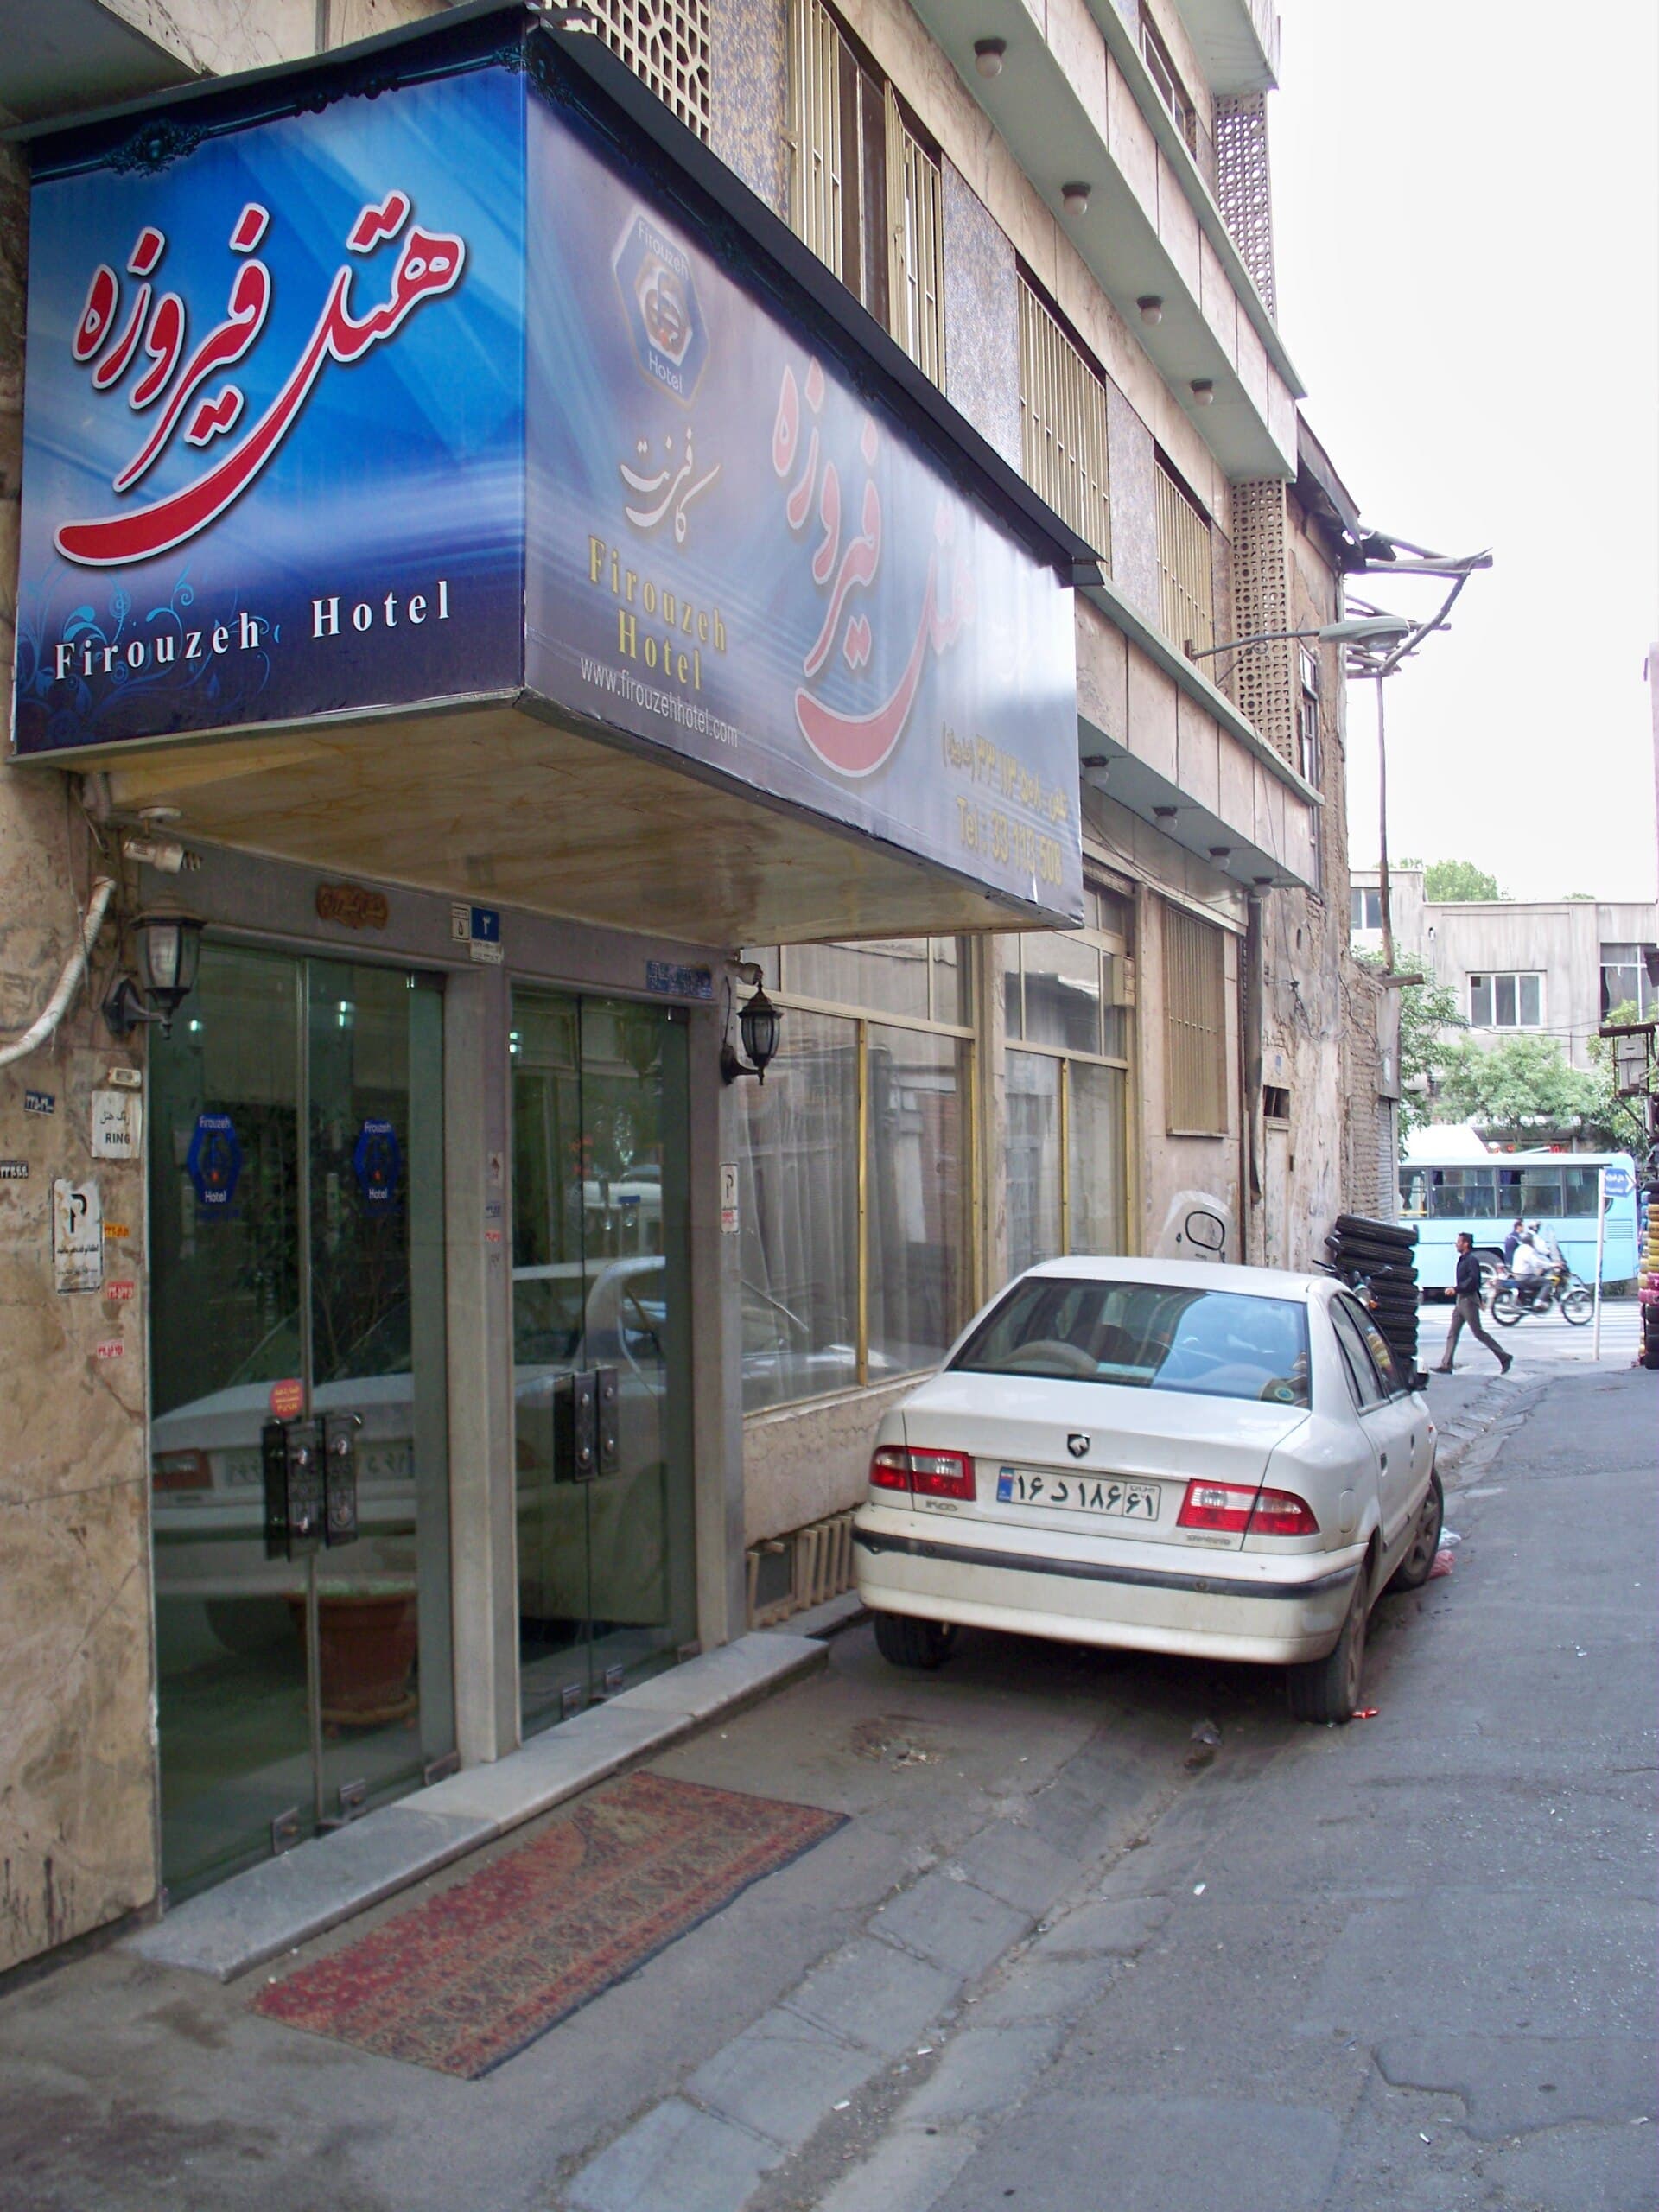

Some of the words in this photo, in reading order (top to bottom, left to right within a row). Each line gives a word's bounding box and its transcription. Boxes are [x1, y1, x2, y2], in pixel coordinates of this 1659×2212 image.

[638, 220, 690, 280] Firouzeh
[54, 189, 465, 565] هتل
[73, 203, 270, 493] فیروزه
[648, 350, 683, 394] Hotel
[772, 355, 881, 677] فیروزه
[55, 614, 261, 680] Firouzeh
[312, 582, 450, 640] Hotel
[588, 536, 726, 652] Firouzeh
[618, 609, 701, 690] Hotel
[581, 657, 738, 747] www.firouzehhotel.com
[105, 1133, 130, 1144] RING
[205, 1190, 226, 1203] Hotel
[368, 1188, 388, 1200] Hotel
